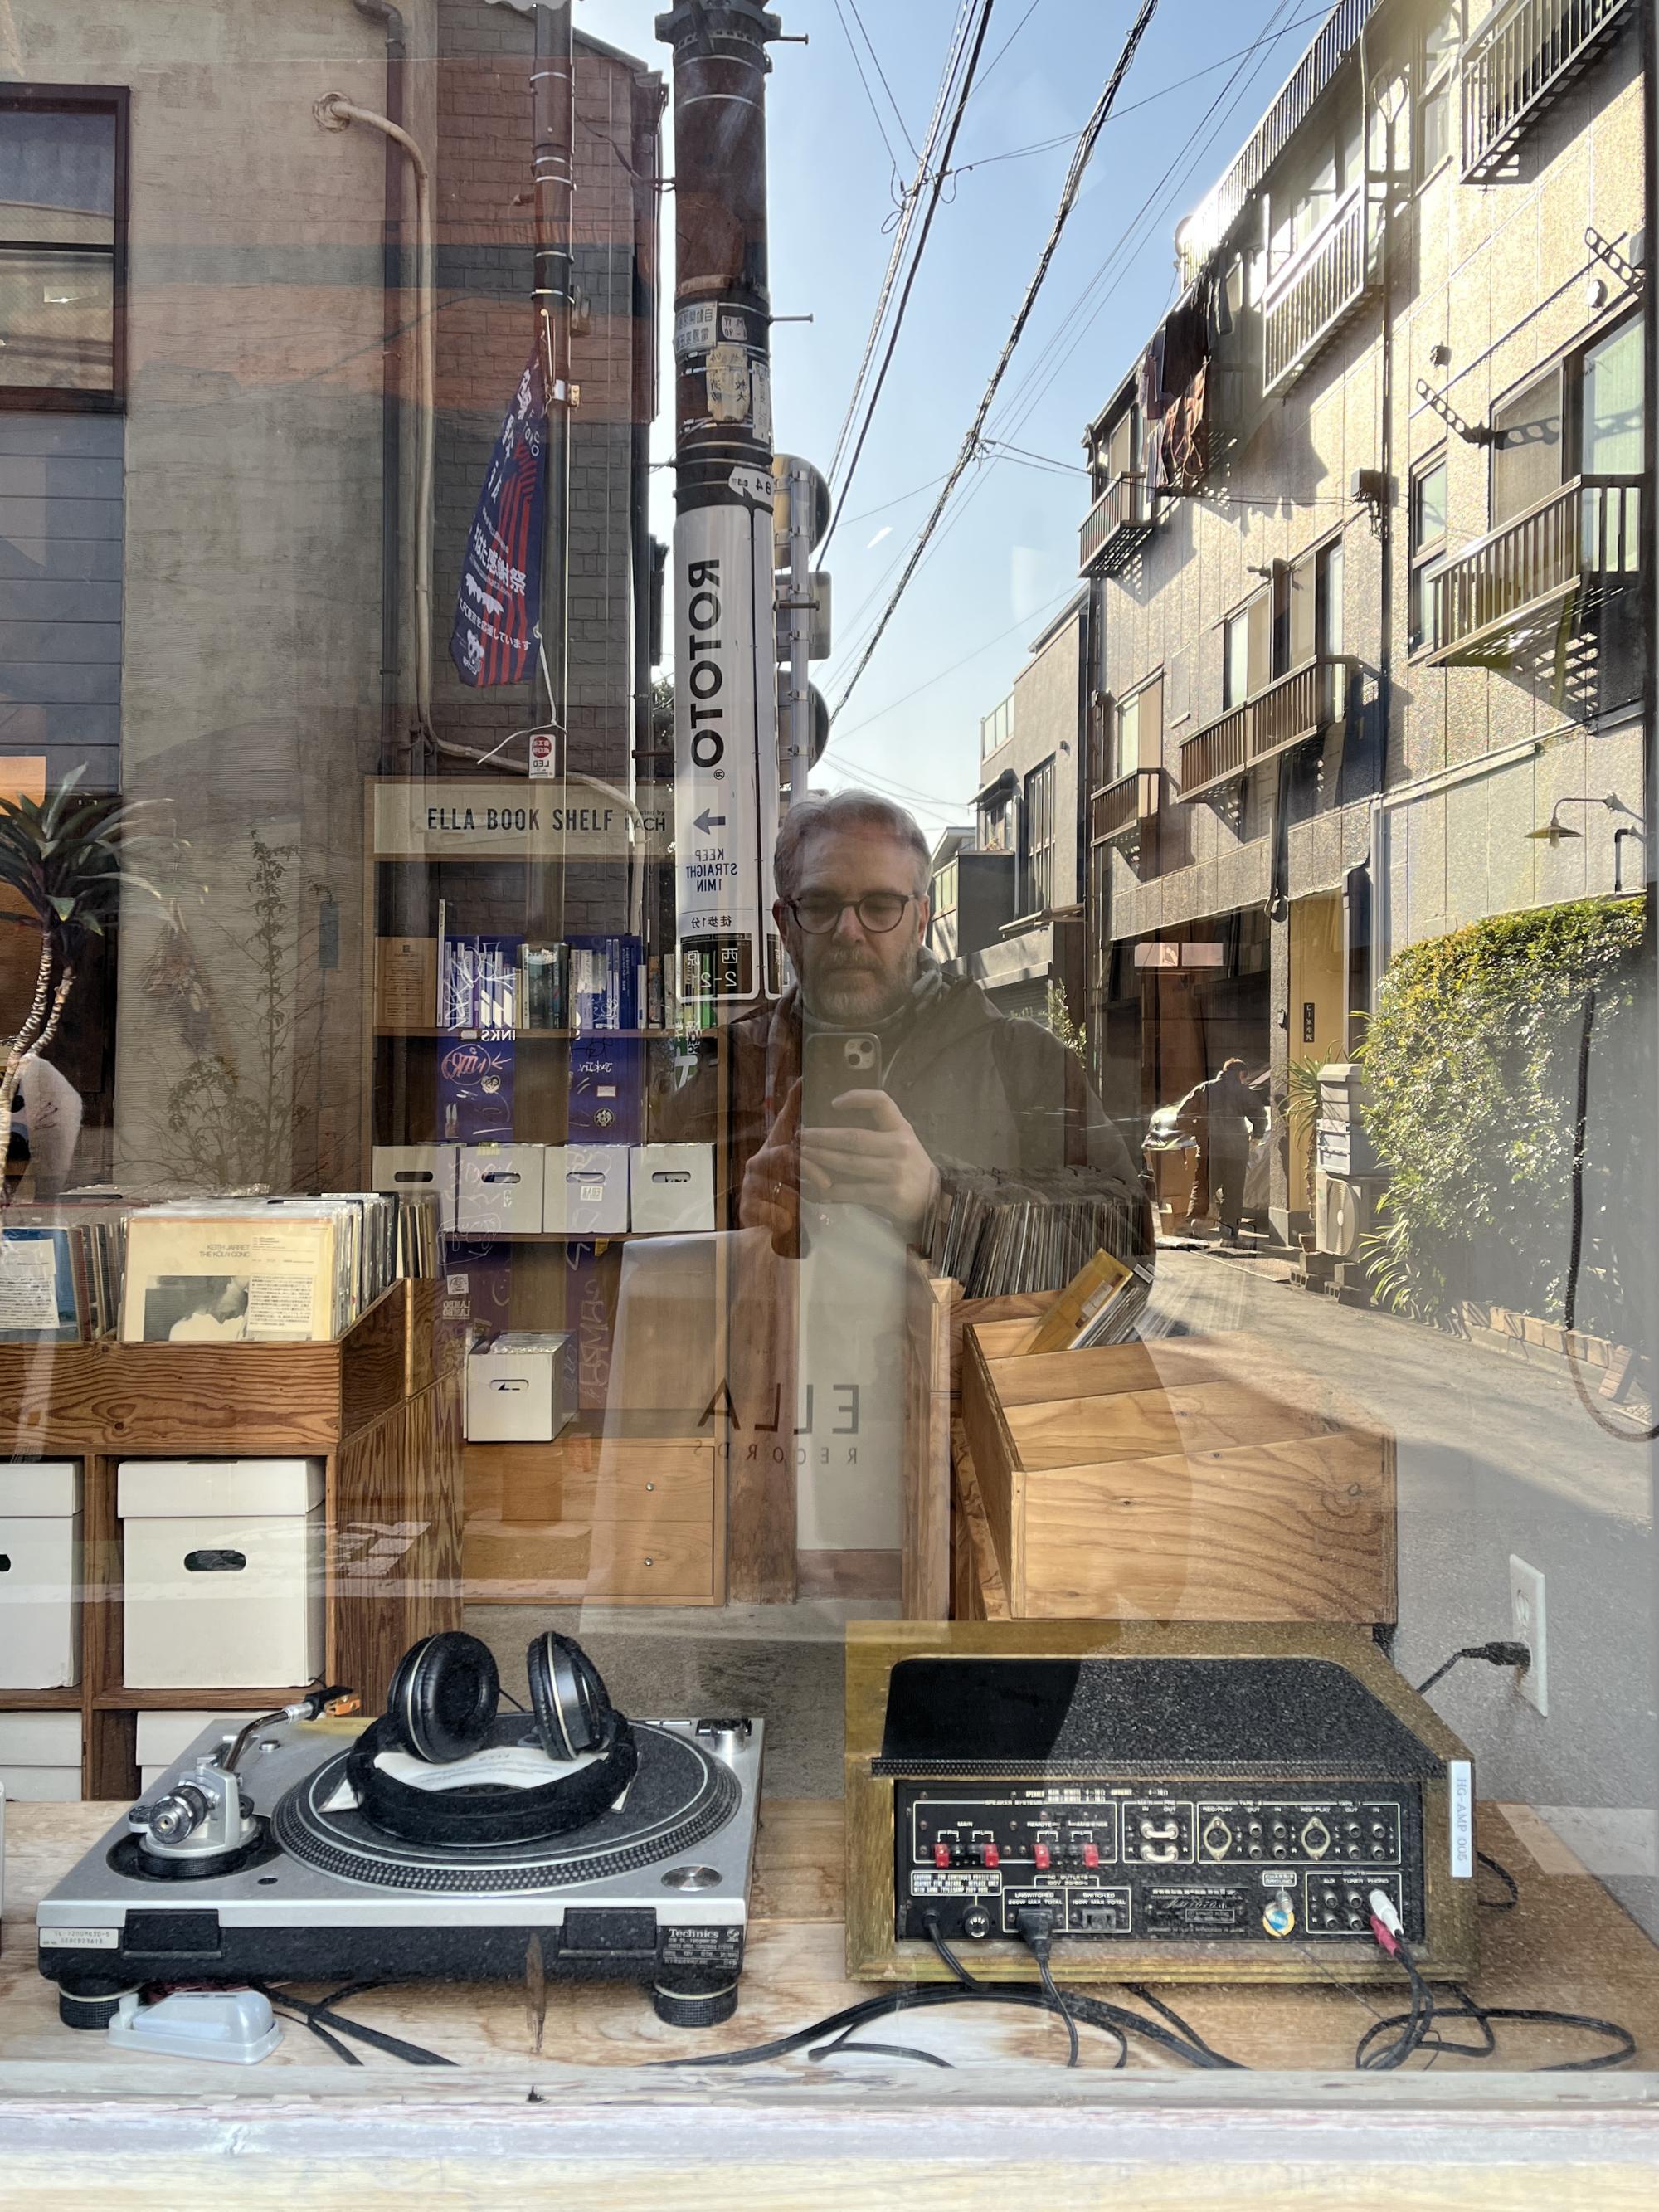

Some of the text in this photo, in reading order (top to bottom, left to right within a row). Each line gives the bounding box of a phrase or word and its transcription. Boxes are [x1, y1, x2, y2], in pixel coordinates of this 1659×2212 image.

[427, 808, 614, 831] ELLA BOOK SHELF
[1457, 1779, 1467, 1862] HG-AMP 005
[668, 1928, 719, 1938] Technics
